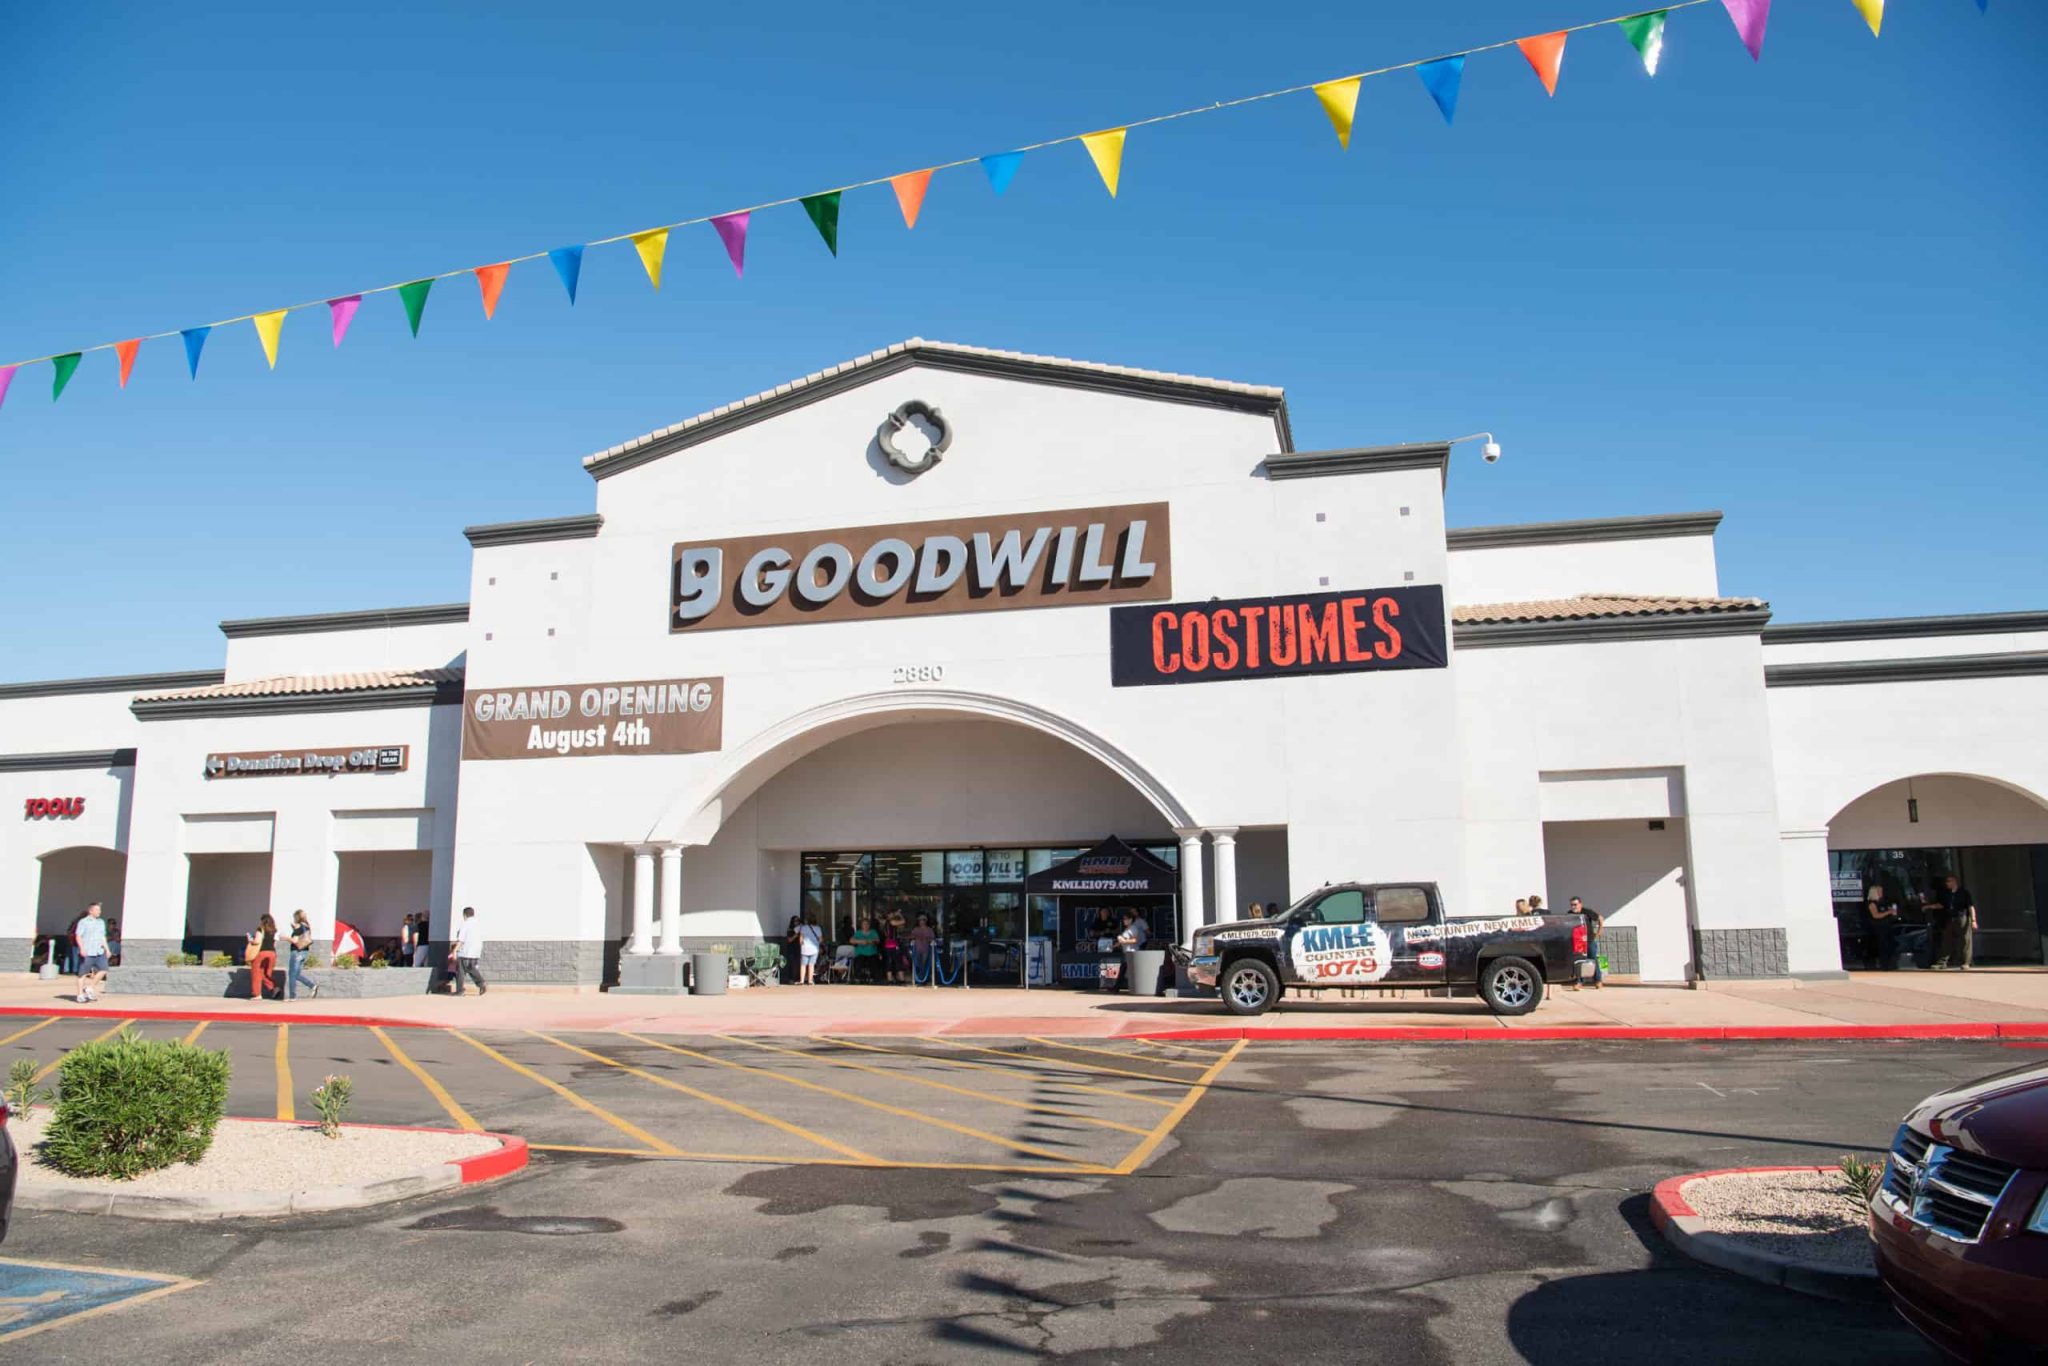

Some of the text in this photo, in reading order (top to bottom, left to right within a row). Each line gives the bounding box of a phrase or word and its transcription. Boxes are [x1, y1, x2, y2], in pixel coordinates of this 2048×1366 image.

[740, 519, 1156, 606] GOODWILL
[1152, 596, 1402, 674] COSTUMES
[893, 665, 943, 683] 2880
[474, 682, 713, 722] GRAND OPENING
[527, 718, 650, 754] August 4th
[227, 749, 379, 771] Donation Drop Off
[25, 796, 86, 818] TOOLS
[1892, 851, 1904, 859] 35
[946, 862, 1011, 874] OODILL
[1052, 879, 1149, 890] KMLE1079.COM
[1483, 920, 1509, 931] NEW
[1511, 917, 1538, 929] KMLE
[1222, 930, 1278, 939] KMLE1079.COM
[1303, 924, 1376, 953] KMLE
[1305, 948, 1376, 962] COUNTRY
[1061, 963, 1099, 978] KMLE
[1315, 957, 1377, 978] 107.9
